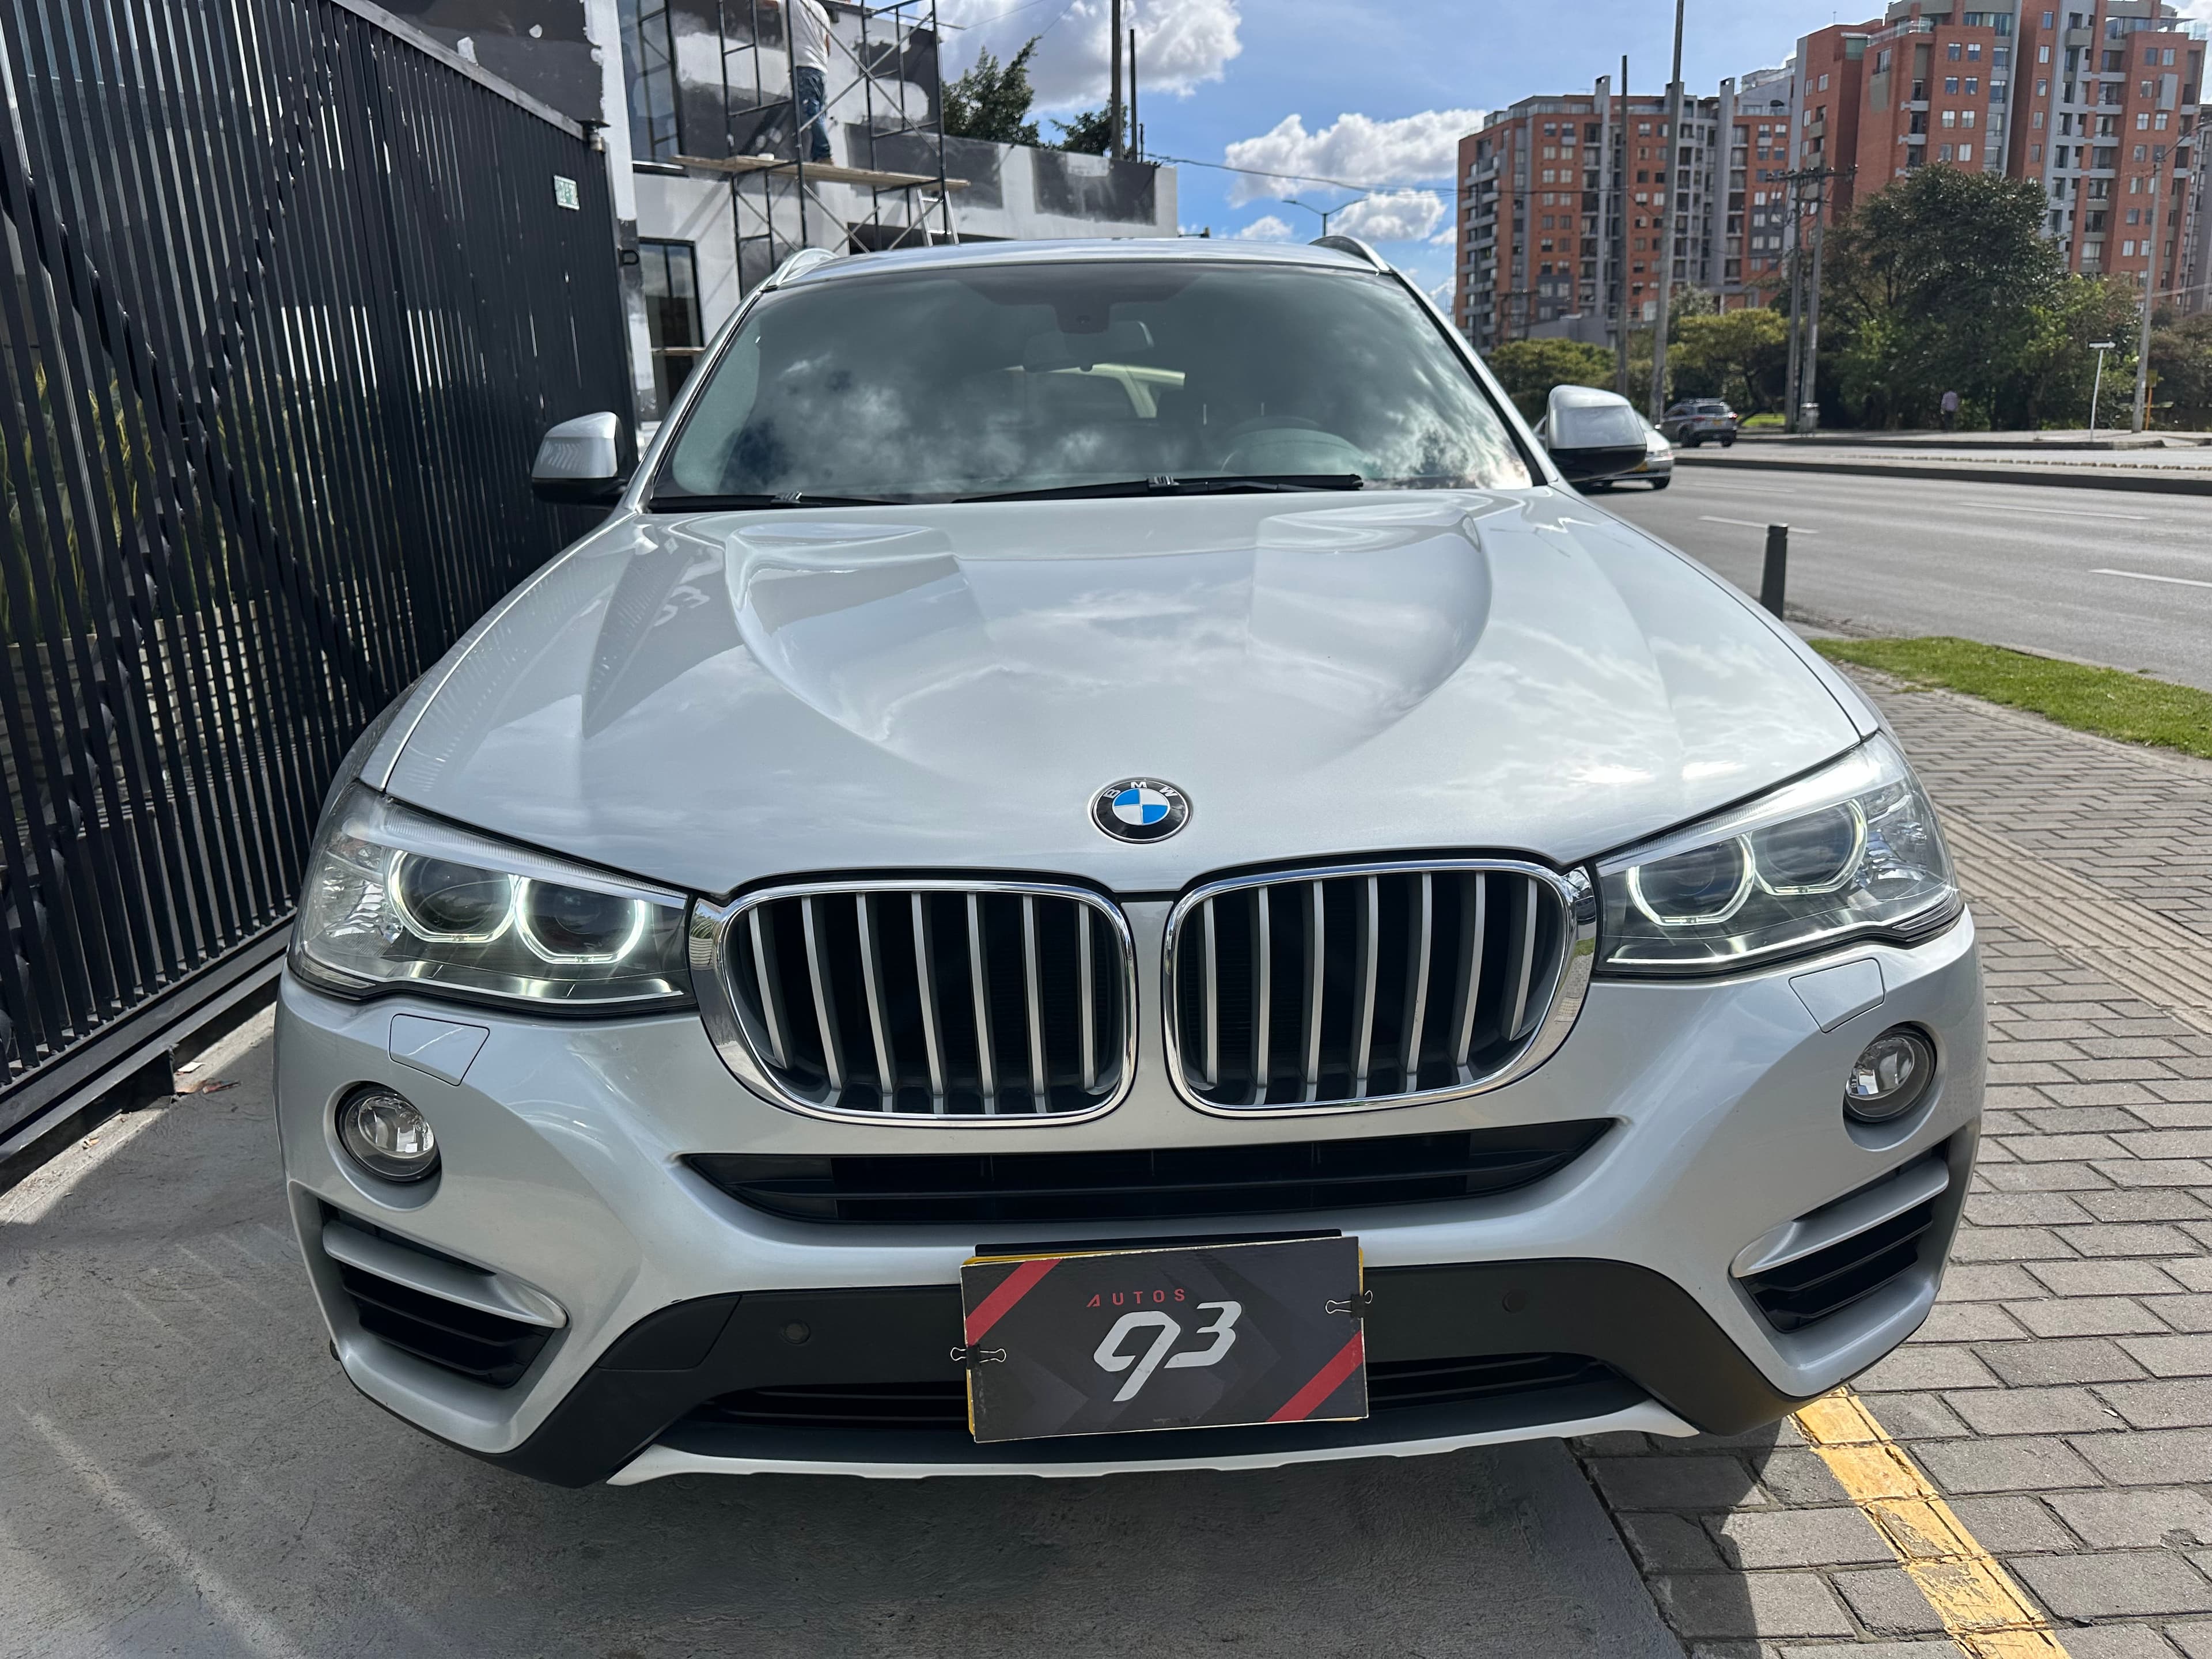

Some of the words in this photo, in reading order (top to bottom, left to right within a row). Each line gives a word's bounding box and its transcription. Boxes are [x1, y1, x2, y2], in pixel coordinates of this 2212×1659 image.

[1103, 781, 1178, 799] BMW
[1086, 1288, 1185, 1308] AUTOS
[1094, 1300, 1243, 1402] 93
